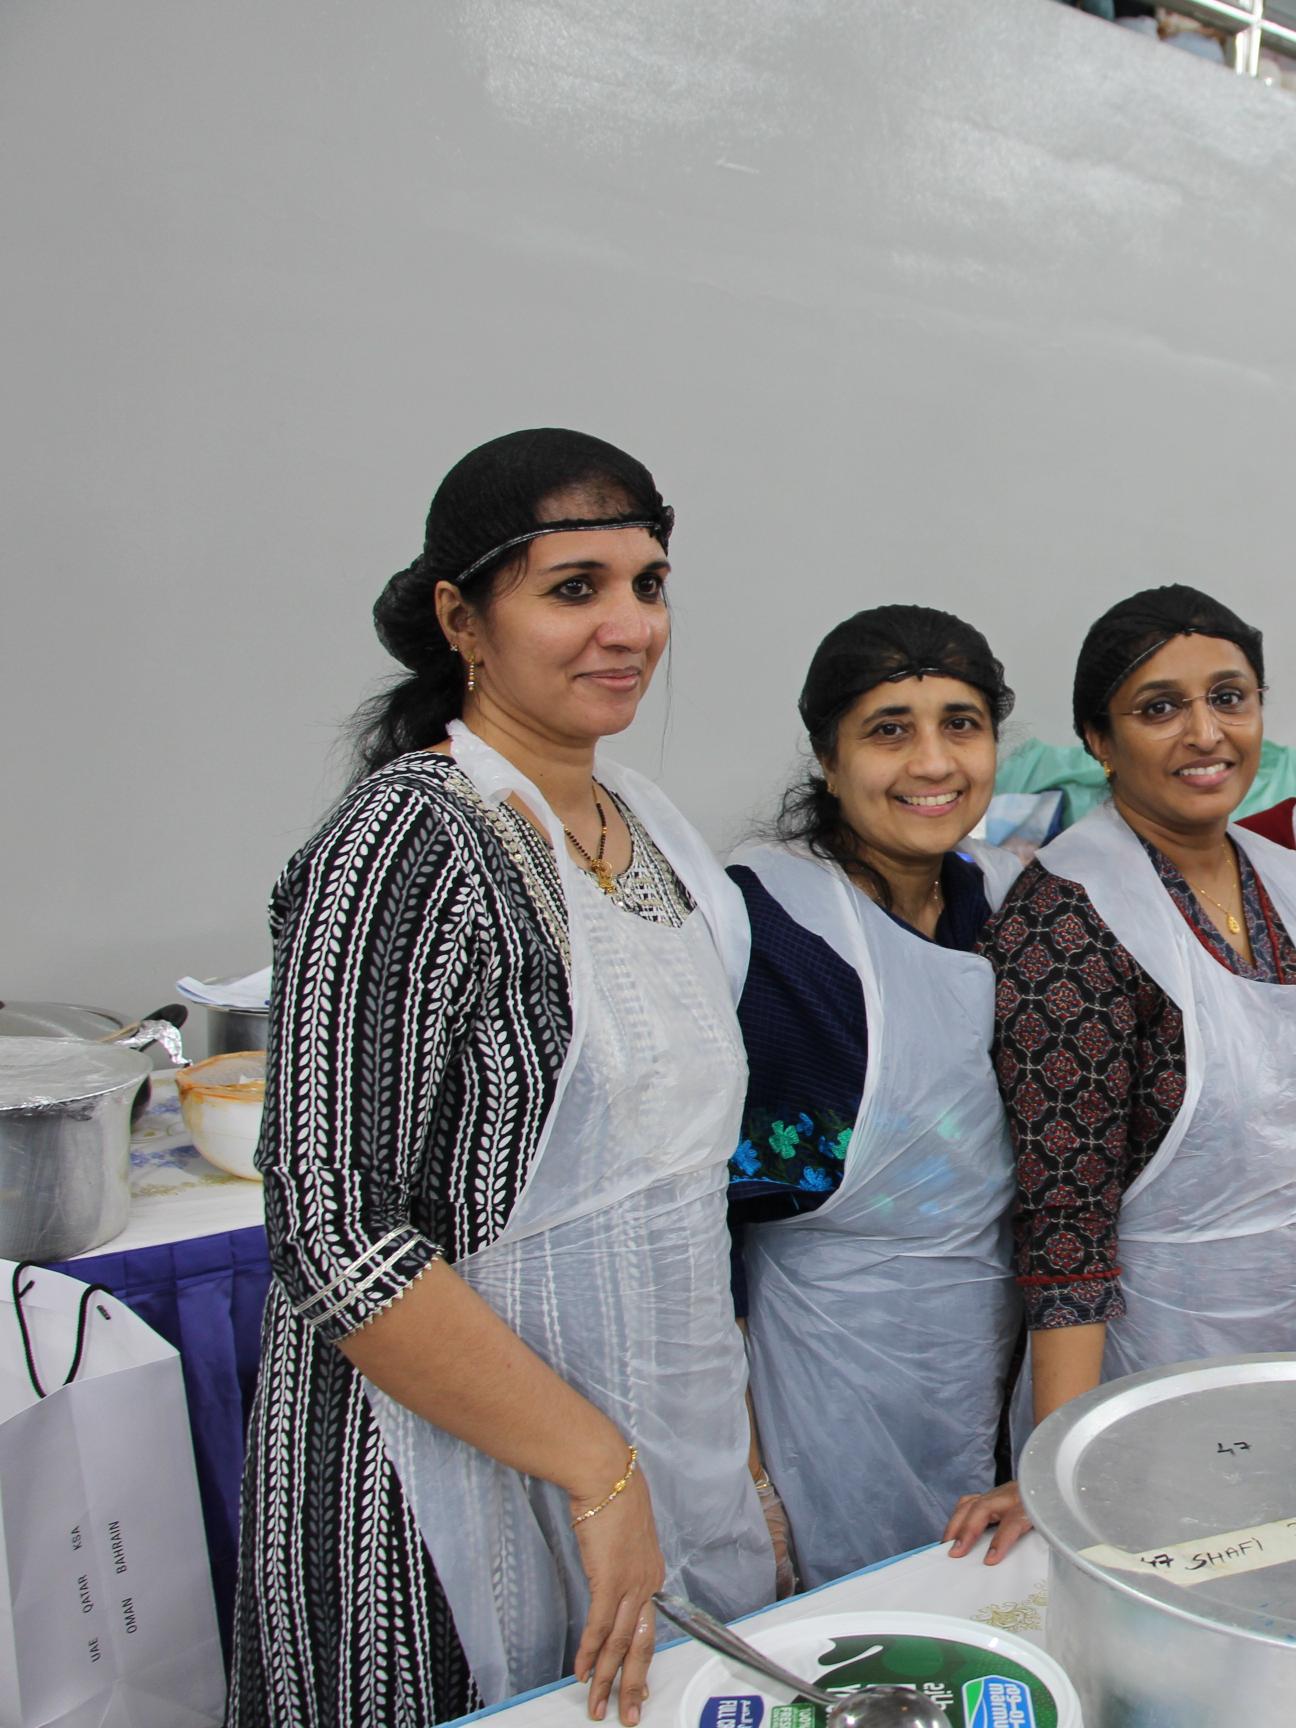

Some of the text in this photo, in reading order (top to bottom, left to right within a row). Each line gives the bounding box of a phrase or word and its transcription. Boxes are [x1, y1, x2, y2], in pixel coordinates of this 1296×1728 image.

[1184, 1536, 1265, 1571] SHAFI
[71, 1525, 101, 1663] UAE QATAR KSA
[108, 1520, 138, 1635] OMAN BAHRAIN
[779, 1706, 793, 1728] FRES
[988, 1683, 1010, 1728] marmu
